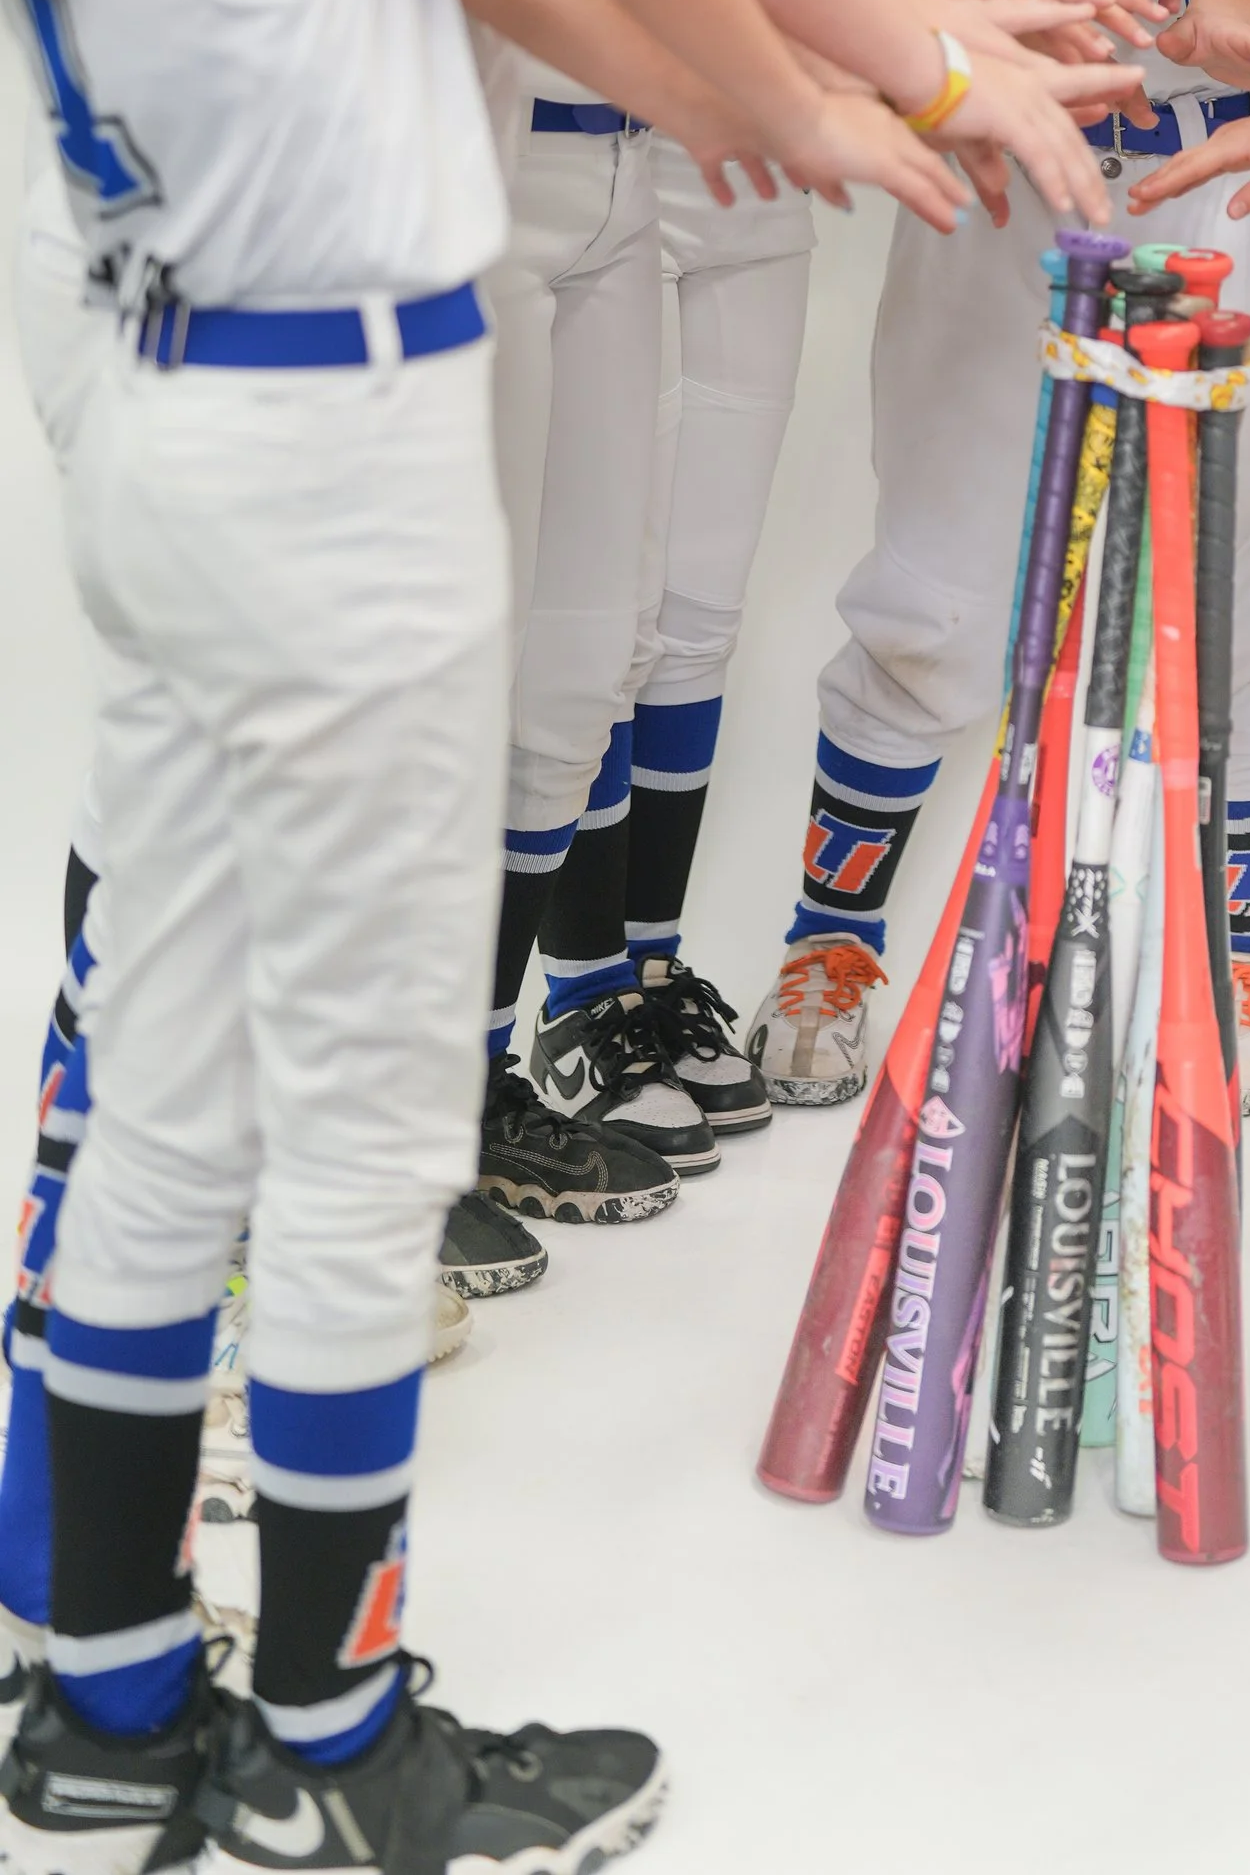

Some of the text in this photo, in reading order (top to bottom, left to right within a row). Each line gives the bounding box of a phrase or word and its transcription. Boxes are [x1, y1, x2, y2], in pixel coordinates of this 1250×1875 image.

[590, 997, 613, 1016] NIKE
[847, 1274, 881, 1378] EASTON
[867, 1136, 954, 1501] LOUISVILLE
[1035, 1153, 1097, 1436] LOUISVILLE
